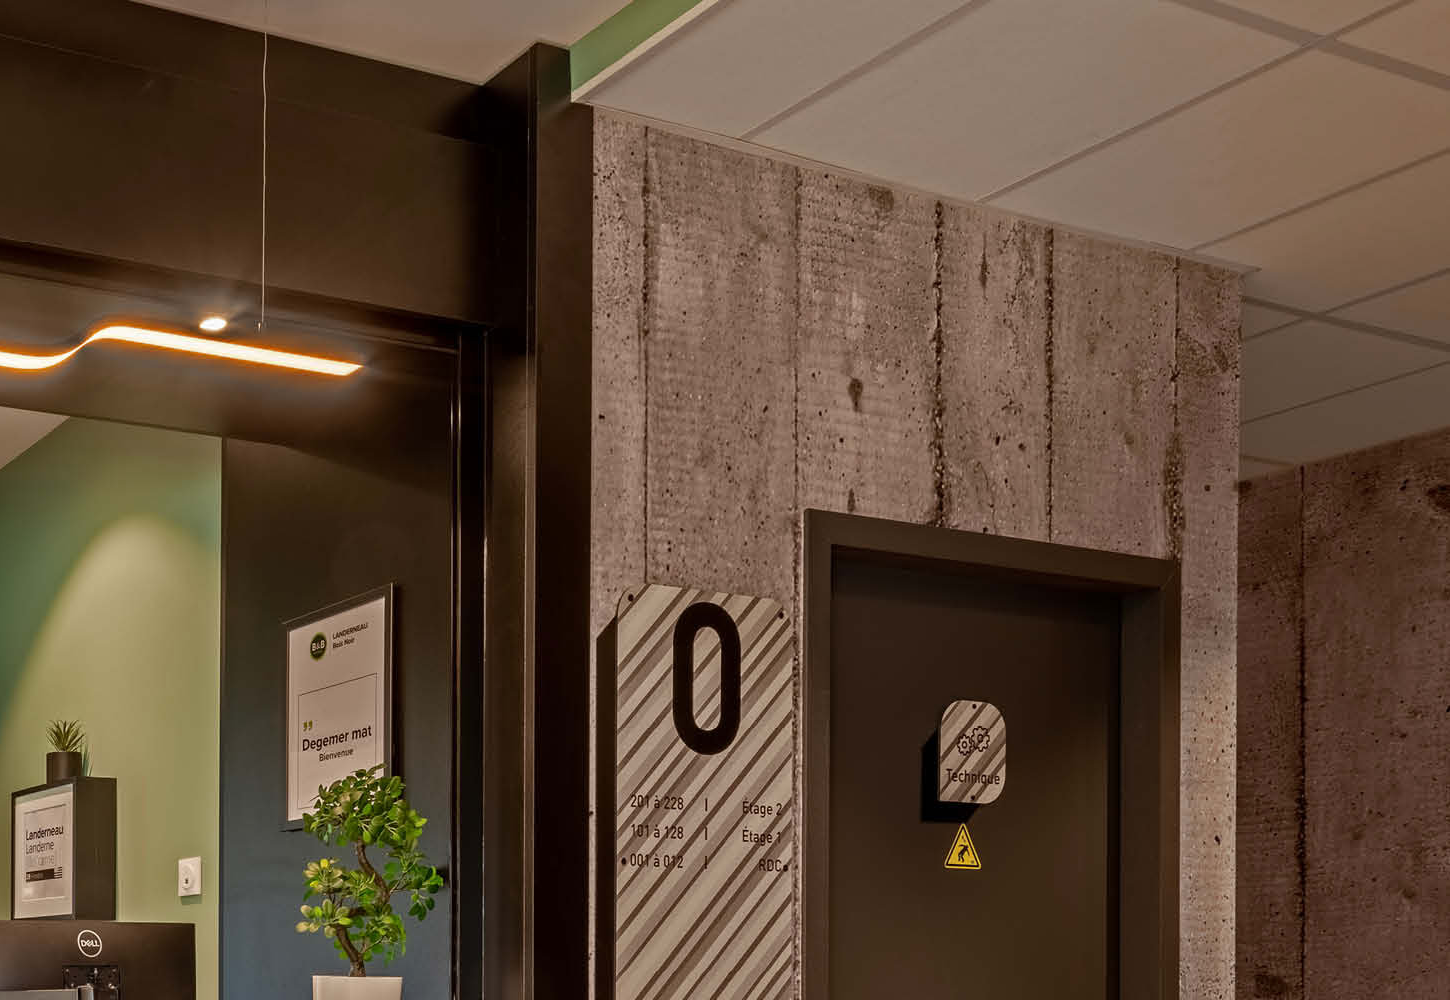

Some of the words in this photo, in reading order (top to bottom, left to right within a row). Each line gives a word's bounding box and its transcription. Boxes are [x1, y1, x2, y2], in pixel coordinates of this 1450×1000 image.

[332, 622, 368, 640] LANDERNEAU
[673, 602, 741, 755] 0
[302, 732, 350, 752] Degemer
[352, 725, 372, 741] mat
[319, 748, 354, 762] Bienvenue
[946, 768, 1000, 786] Technique
[630, 794, 649, 808] 201
[654, 795, 660, 809] à
[664, 796, 684, 810] 228
[742, 797, 773, 818] Étage
[776, 803, 783, 816] 2
[25, 826, 64, 841] Landerneau
[631, 824, 649, 838] 101
[654, 824, 660, 838] à
[665, 826, 684, 839] 128
[742, 826, 773, 846] Étage
[777, 832, 782, 844] 1
[630, 853, 649, 867] 001
[654, 853, 660, 867] à
[664, 855, 684, 869] 012
[758, 858, 782, 872] RDC
[80, 939, 100, 947] DELL
